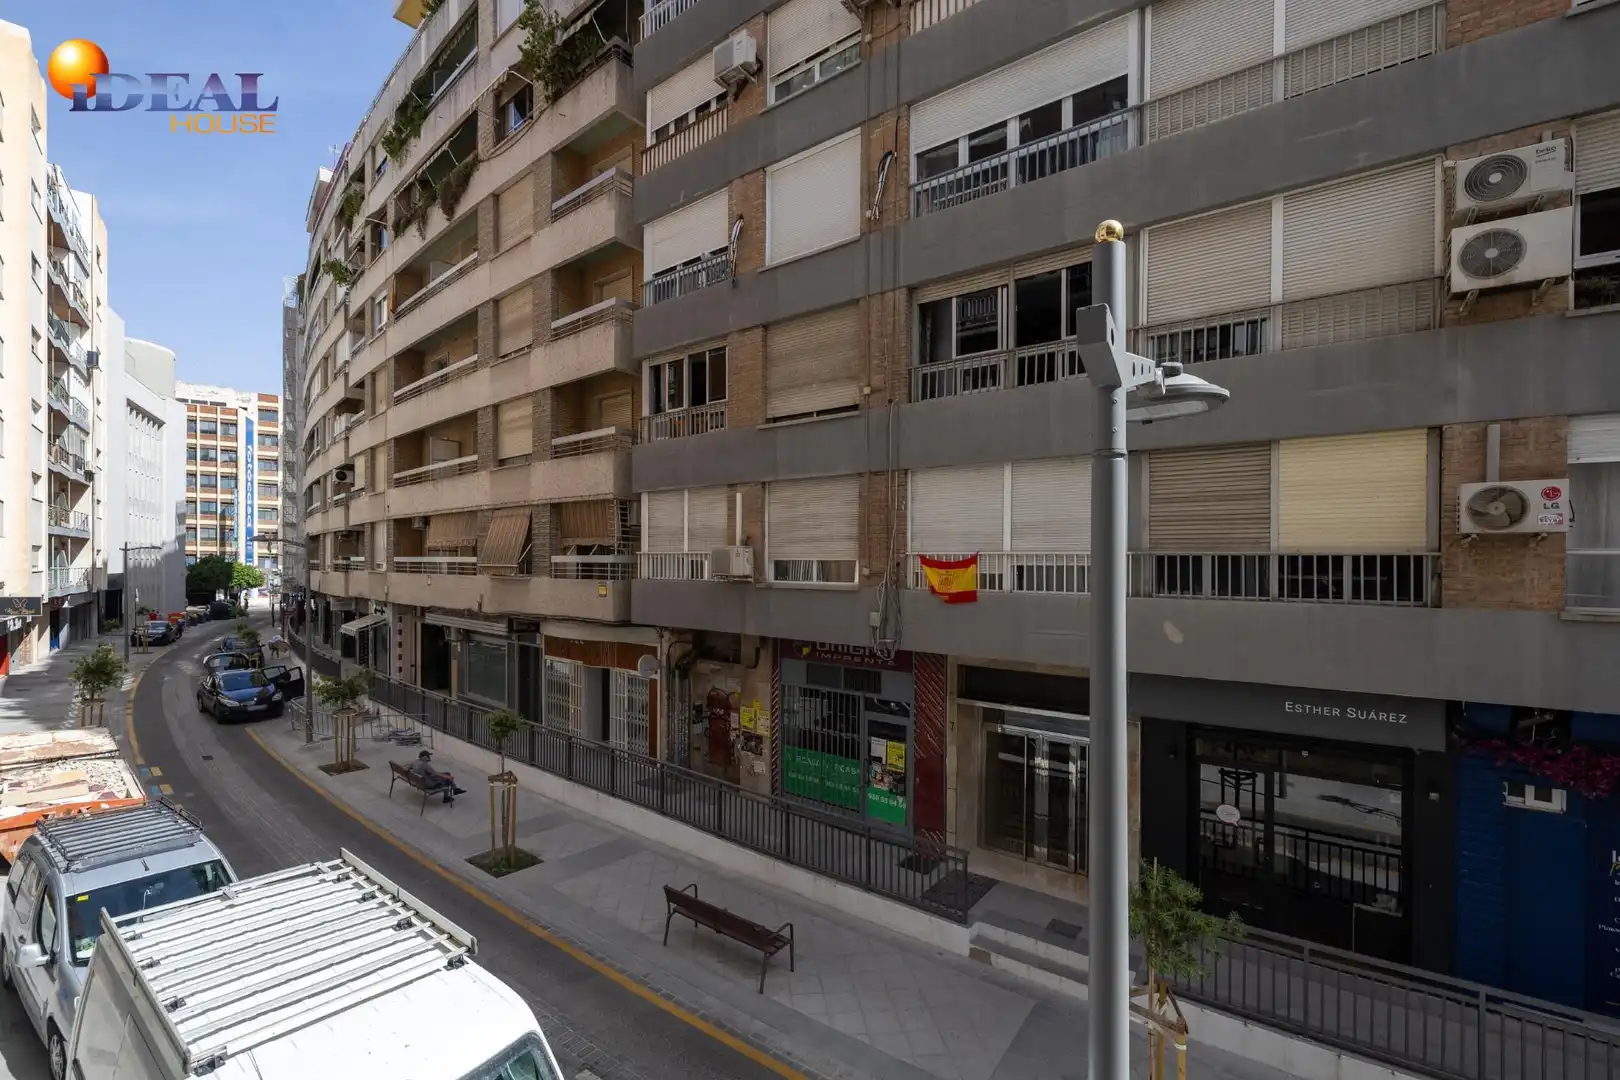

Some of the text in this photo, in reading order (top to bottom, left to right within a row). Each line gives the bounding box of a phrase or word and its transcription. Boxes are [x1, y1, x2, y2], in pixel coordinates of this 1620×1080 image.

[816, 651, 896, 666] IMPRENTA
[1285, 701, 1408, 724] ESTHER SUÁREZ
